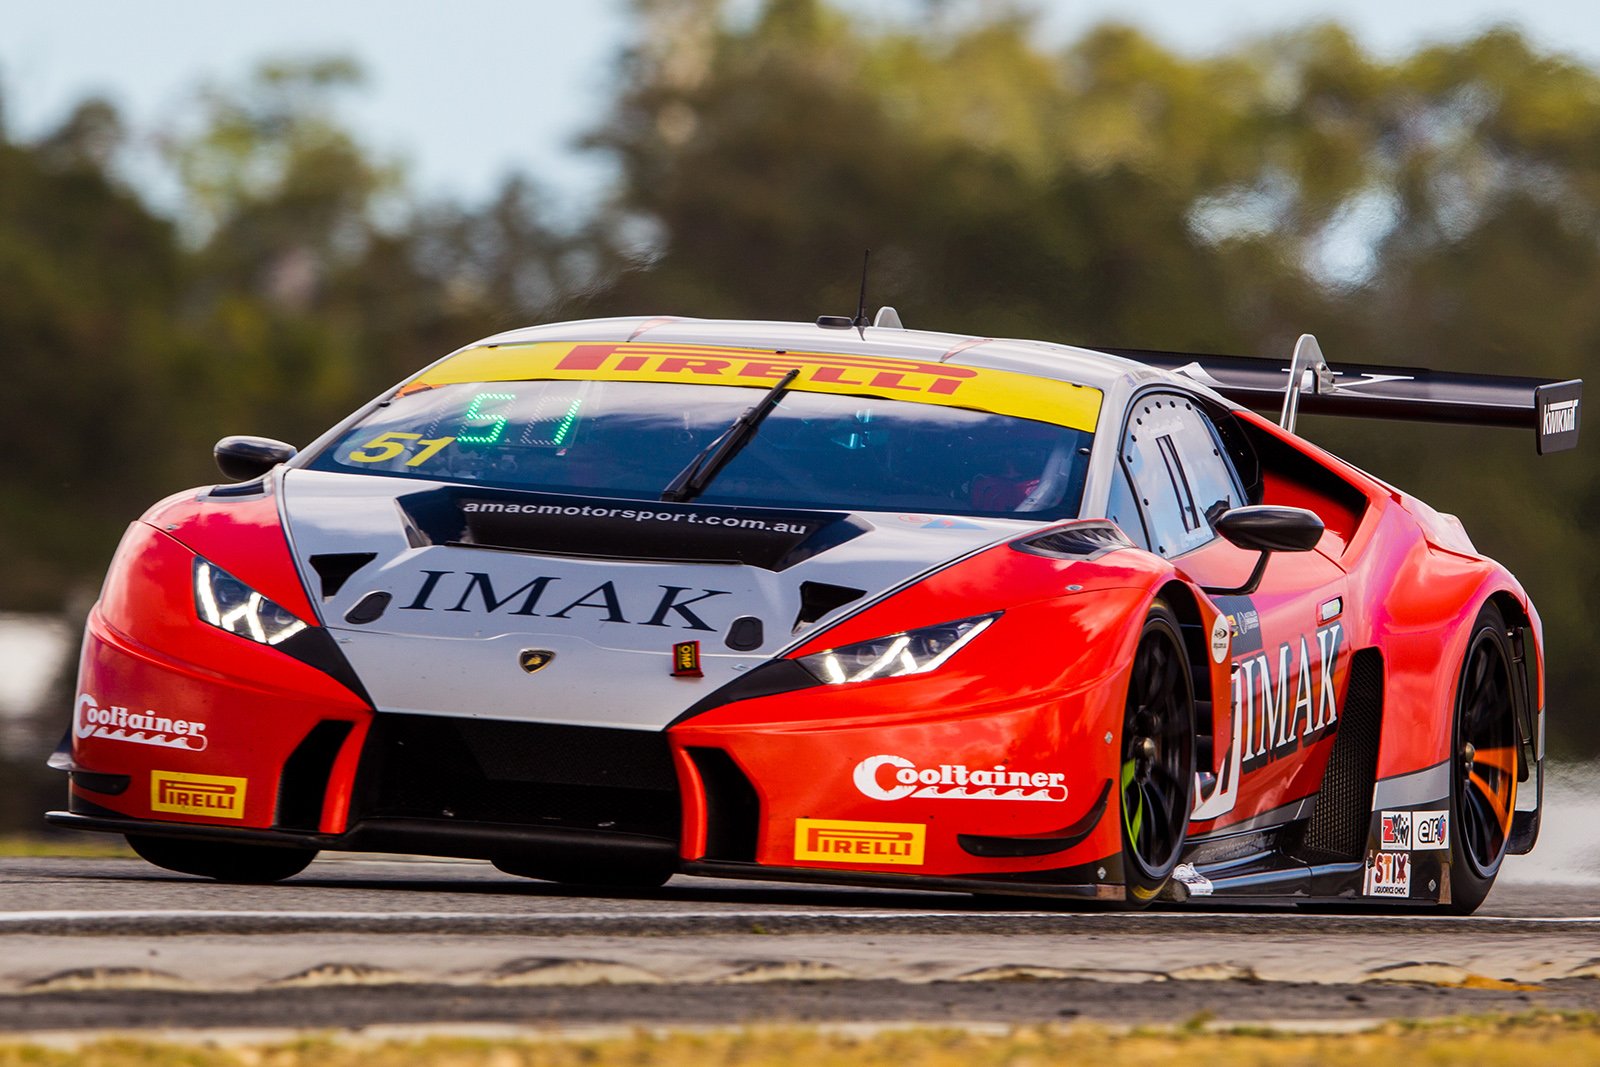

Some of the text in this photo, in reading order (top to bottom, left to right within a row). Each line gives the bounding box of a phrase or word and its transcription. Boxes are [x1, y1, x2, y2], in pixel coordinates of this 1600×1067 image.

[555, 344, 979, 395] PIRELLI
[456, 392, 583, 446] 51
[350, 431, 456, 467] 51
[463, 500, 806, 535] amacmotorsport.com.au
[398, 569, 733, 632] IMAK
[681, 645, 693, 669] OMP
[1241, 624, 1339, 763] IMAK
[73, 693, 207, 742] Cooltainer
[159, 779, 237, 810] PIRELLI
[853, 754, 1066, 802] Cooltainer
[806, 827, 914, 857] PIRELLI
[1375, 853, 1408, 885] STIX
